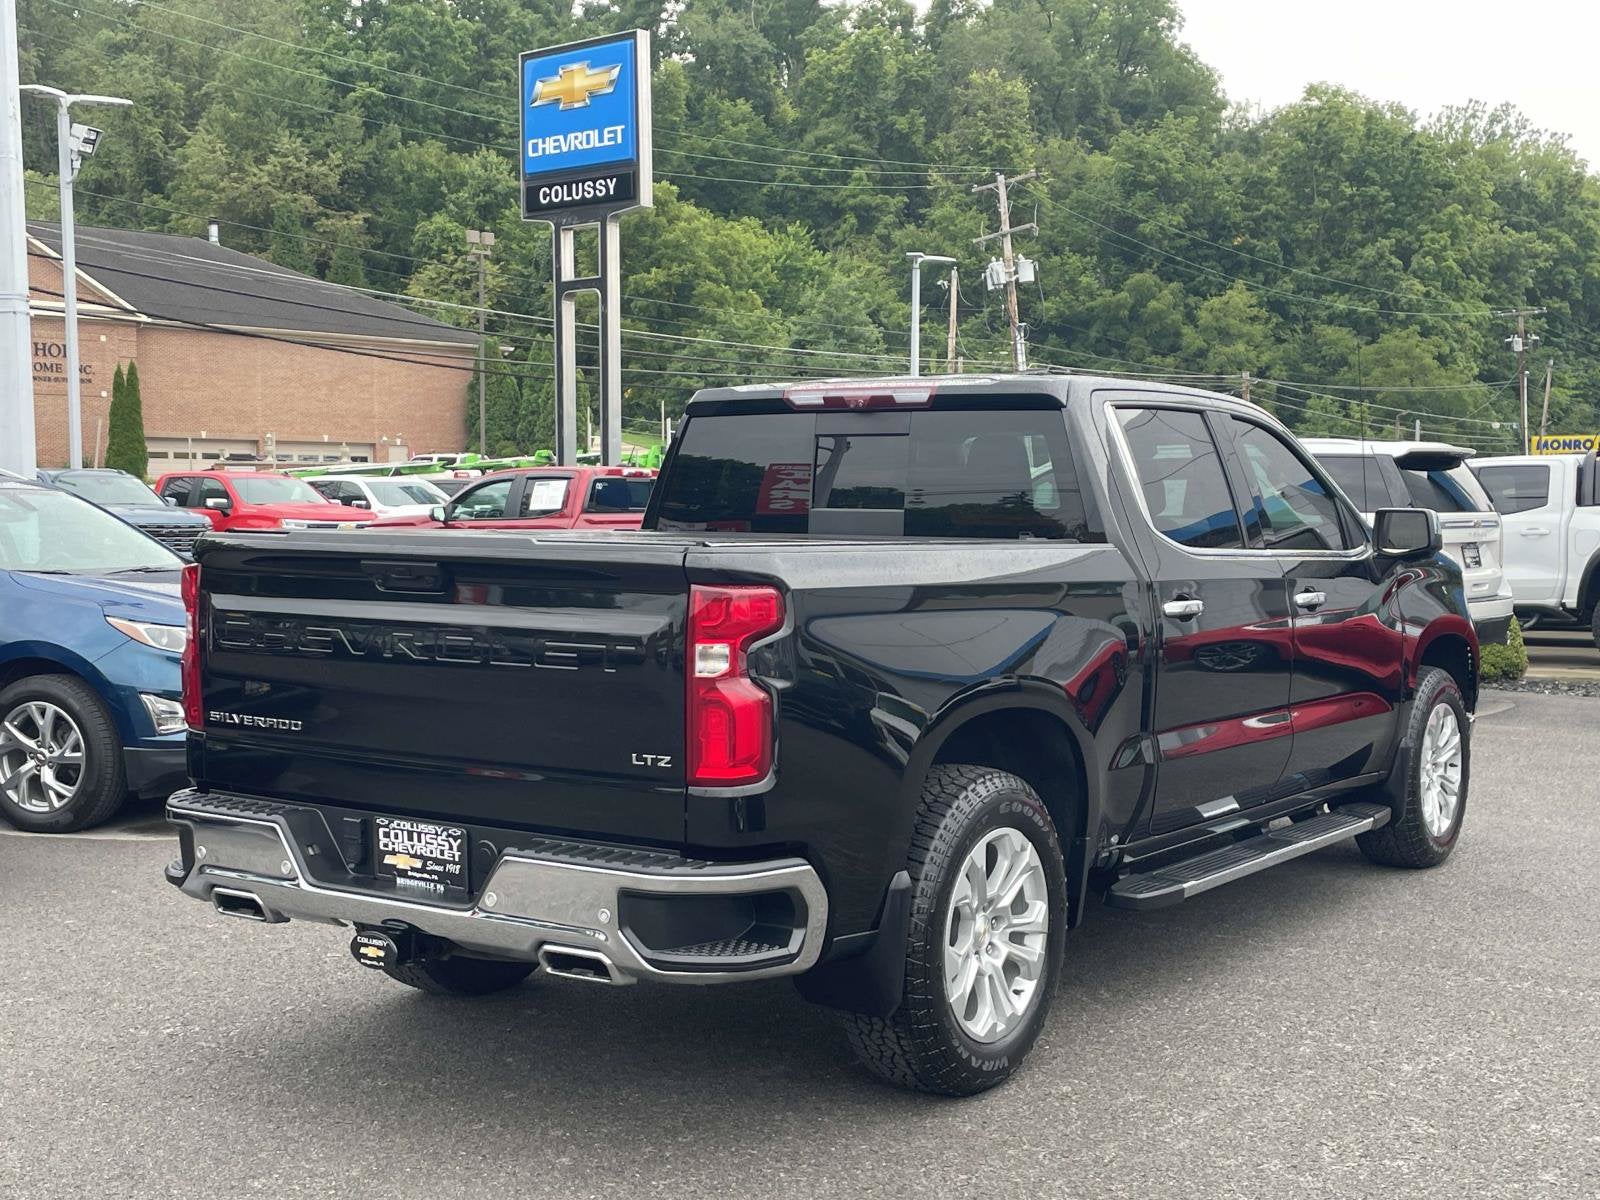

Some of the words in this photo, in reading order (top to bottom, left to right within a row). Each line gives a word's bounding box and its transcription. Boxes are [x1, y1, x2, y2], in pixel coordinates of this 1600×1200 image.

[528, 125, 625, 158] CHEVROLET
[539, 177, 617, 204] COLUSSY
[33, 361, 63, 373] OME
[1536, 438, 1595, 451] MONRO
[219, 613, 640, 673] CHEVROLET
[209, 710, 302, 731] SILVERADO
[631, 753, 672, 767] LTZ
[393, 820, 444, 835] COLUSSY
[378, 827, 462, 852] COLUSSY
[379, 840, 461, 862] CHEVROLET
[425, 860, 444, 872] Since
[445, 863, 461, 875] 1918
[357, 936, 388, 947] COLUSSY
